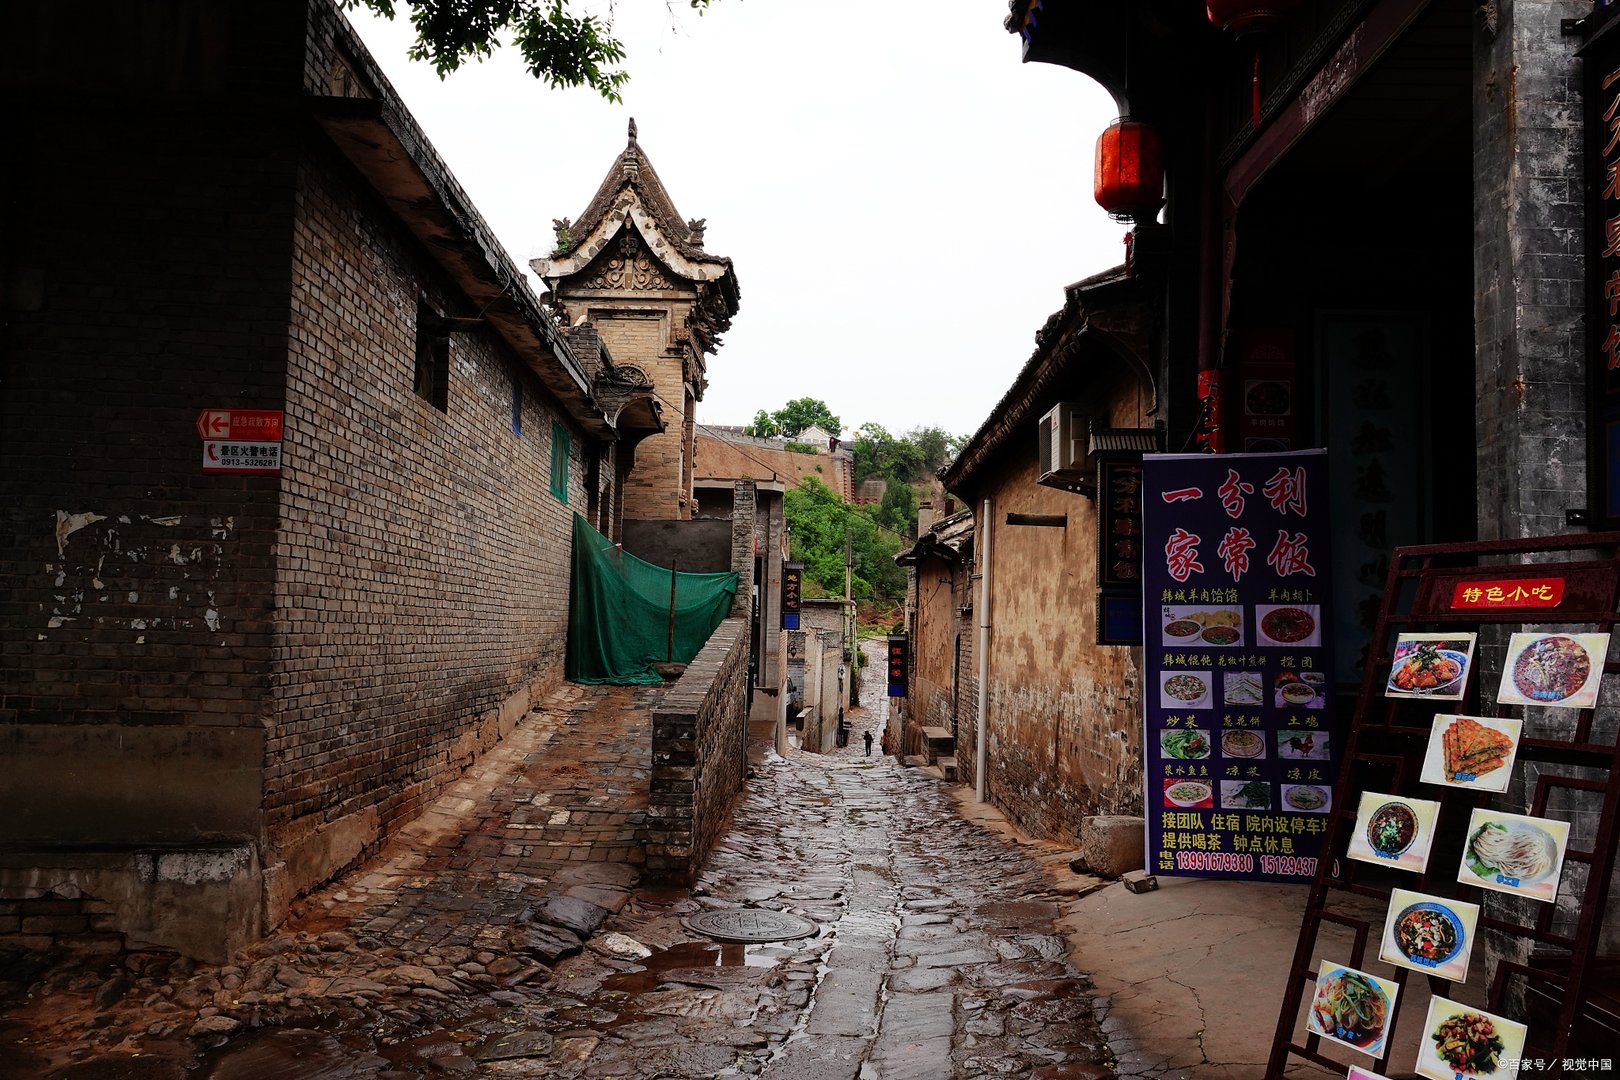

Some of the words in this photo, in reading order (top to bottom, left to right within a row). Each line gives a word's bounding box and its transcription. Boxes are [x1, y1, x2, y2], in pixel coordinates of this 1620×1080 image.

[232, 415, 279, 428] 应急疏散方向
[221, 445, 278, 457] 景区火警电话
[221, 459, 277, 467] 0913-5326281
[1162, 466, 1307, 518] 一分利
[1165, 527, 1316, 583] 家常饭
[1161, 588, 1239, 603] 韩城羊肉饸饹
[1268, 588, 1313, 603] 羊肉胡卜
[1461, 584, 1554, 603] 特色小吃
[1163, 654, 1213, 668] 韩城馄饨
[1166, 714, 1199, 729] 炒菜
[1223, 714, 1261, 727] 葱花饼
[1287, 714, 1319, 728] 土鸡
[1226, 765, 1261, 778] 凉菜
[1287, 767, 1323, 782] 凉皮
[1162, 812, 1205, 830] 接团队
[1211, 813, 1241, 832] 住宿
[1162, 832, 1222, 851] 提供喝茶
[1233, 834, 1295, 855] 钟点休息
[1158, 850, 1175, 871] 电话
[1176, 851, 1254, 873] 13991679380
